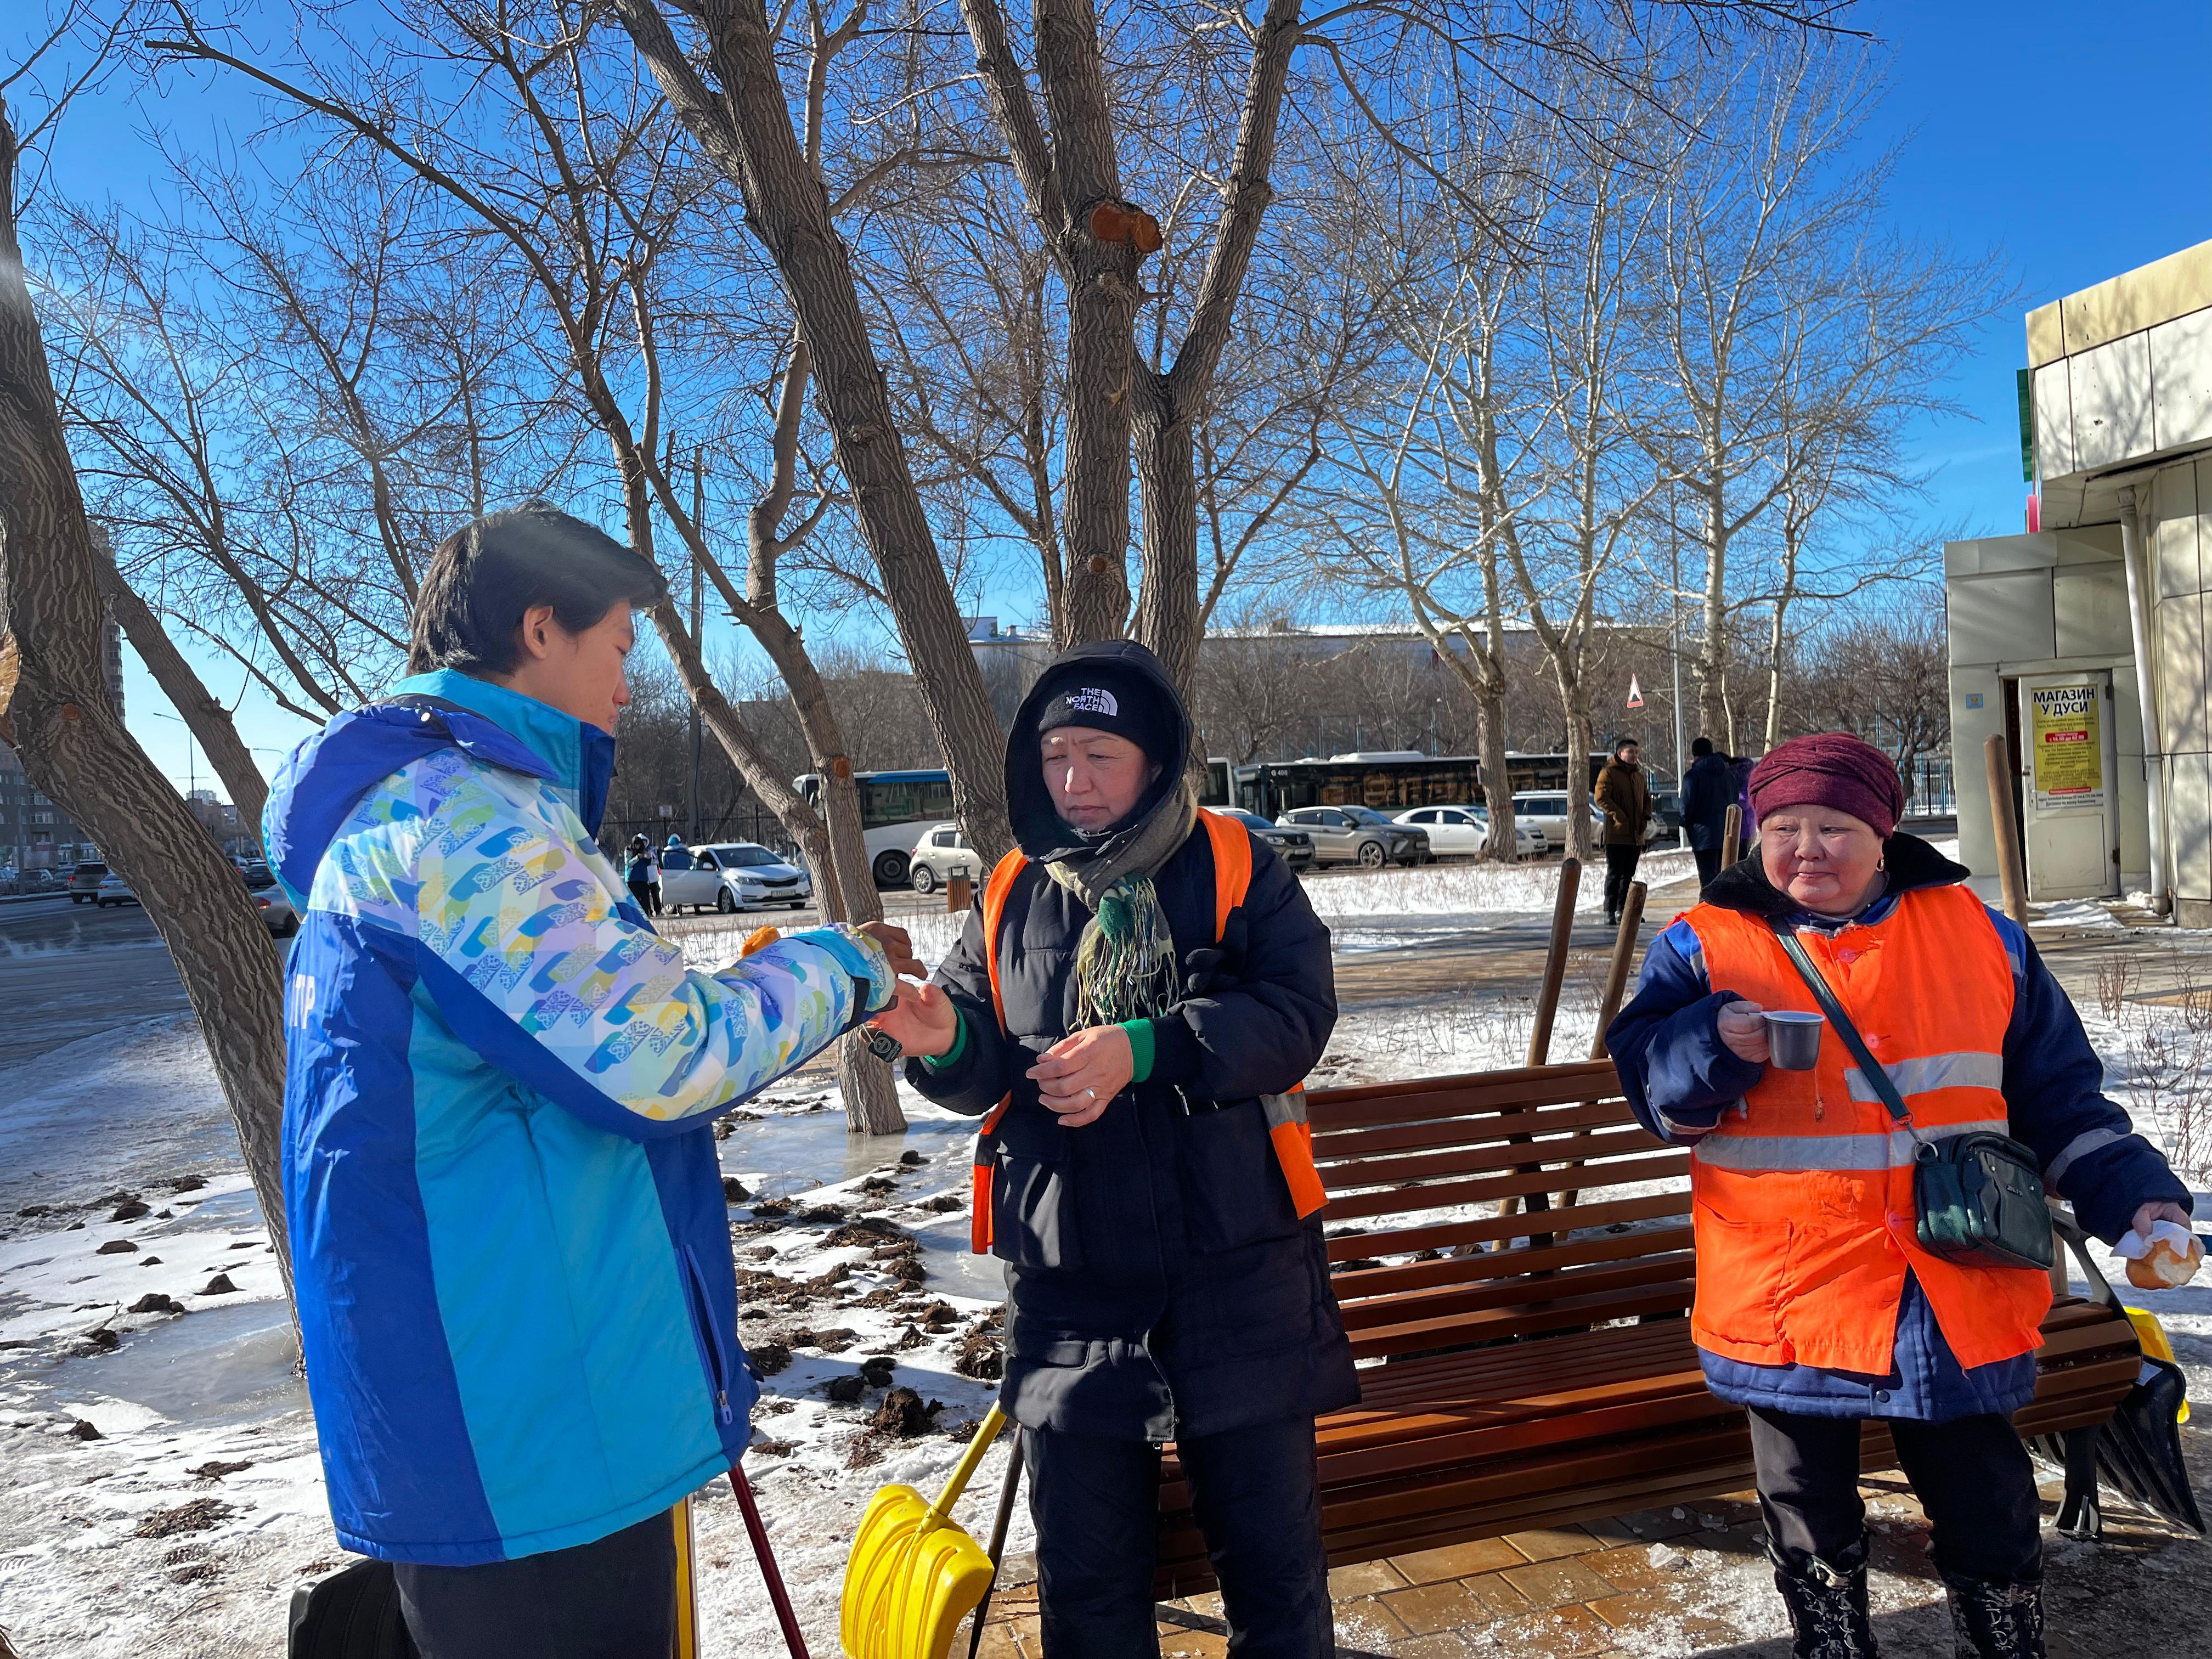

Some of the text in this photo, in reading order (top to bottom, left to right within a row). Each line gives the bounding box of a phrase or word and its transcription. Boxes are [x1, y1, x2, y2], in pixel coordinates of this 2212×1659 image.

[1080, 687, 1102, 696] THE
[2033, 688, 2095, 703] МАГАЗИН
[1065, 695, 1100, 705] NORTH
[1073, 703, 1099, 712] FACE
[2041, 702, 2089, 716] У ДУСИ
